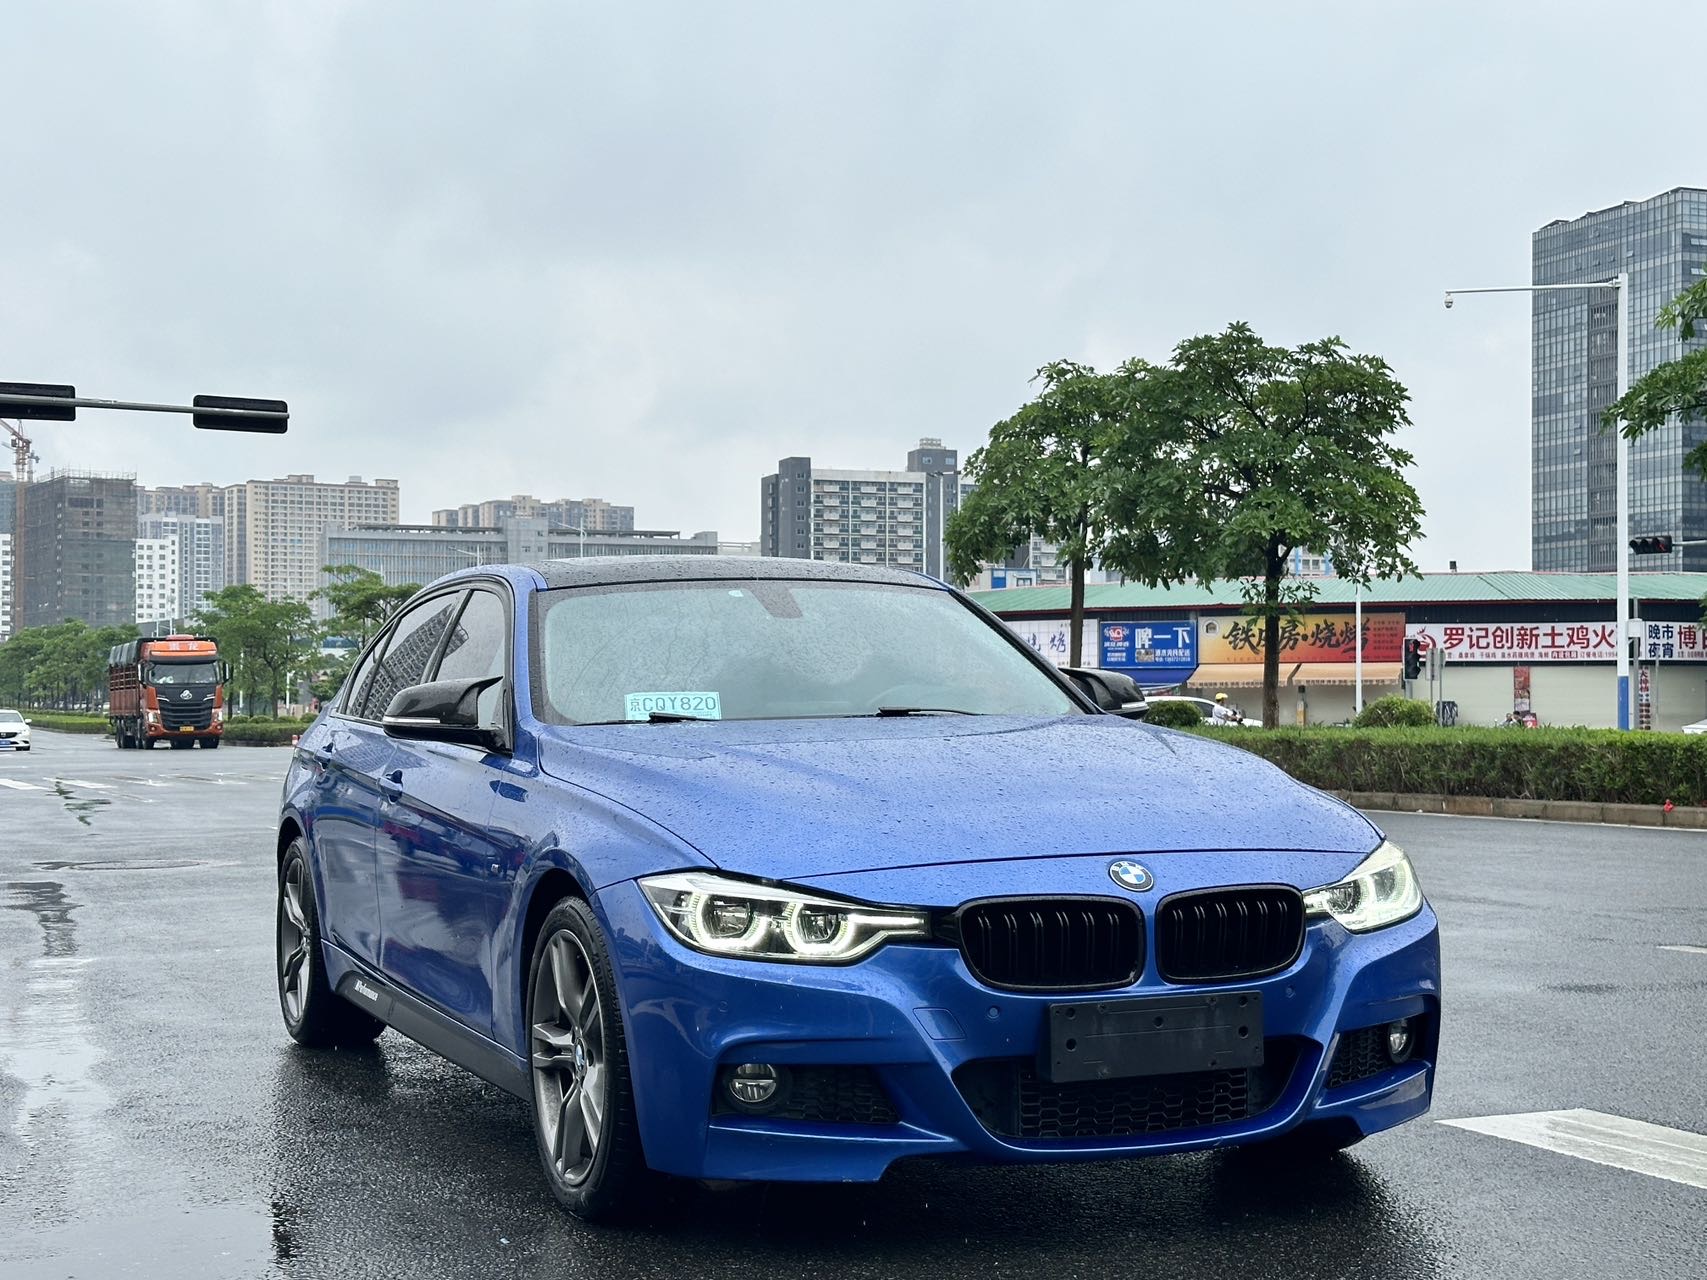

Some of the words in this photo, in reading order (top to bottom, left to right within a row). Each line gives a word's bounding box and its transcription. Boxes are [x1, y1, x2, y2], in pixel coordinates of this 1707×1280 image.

[1135, 626, 1191, 648] 啤一下
[1443, 624, 1617, 650] 罗记创新土鸡火
[1648, 624, 1674, 640] 晚市
[1648, 642, 1674, 658] 夜宵
[629, 695, 717, 712] 京CQY820
